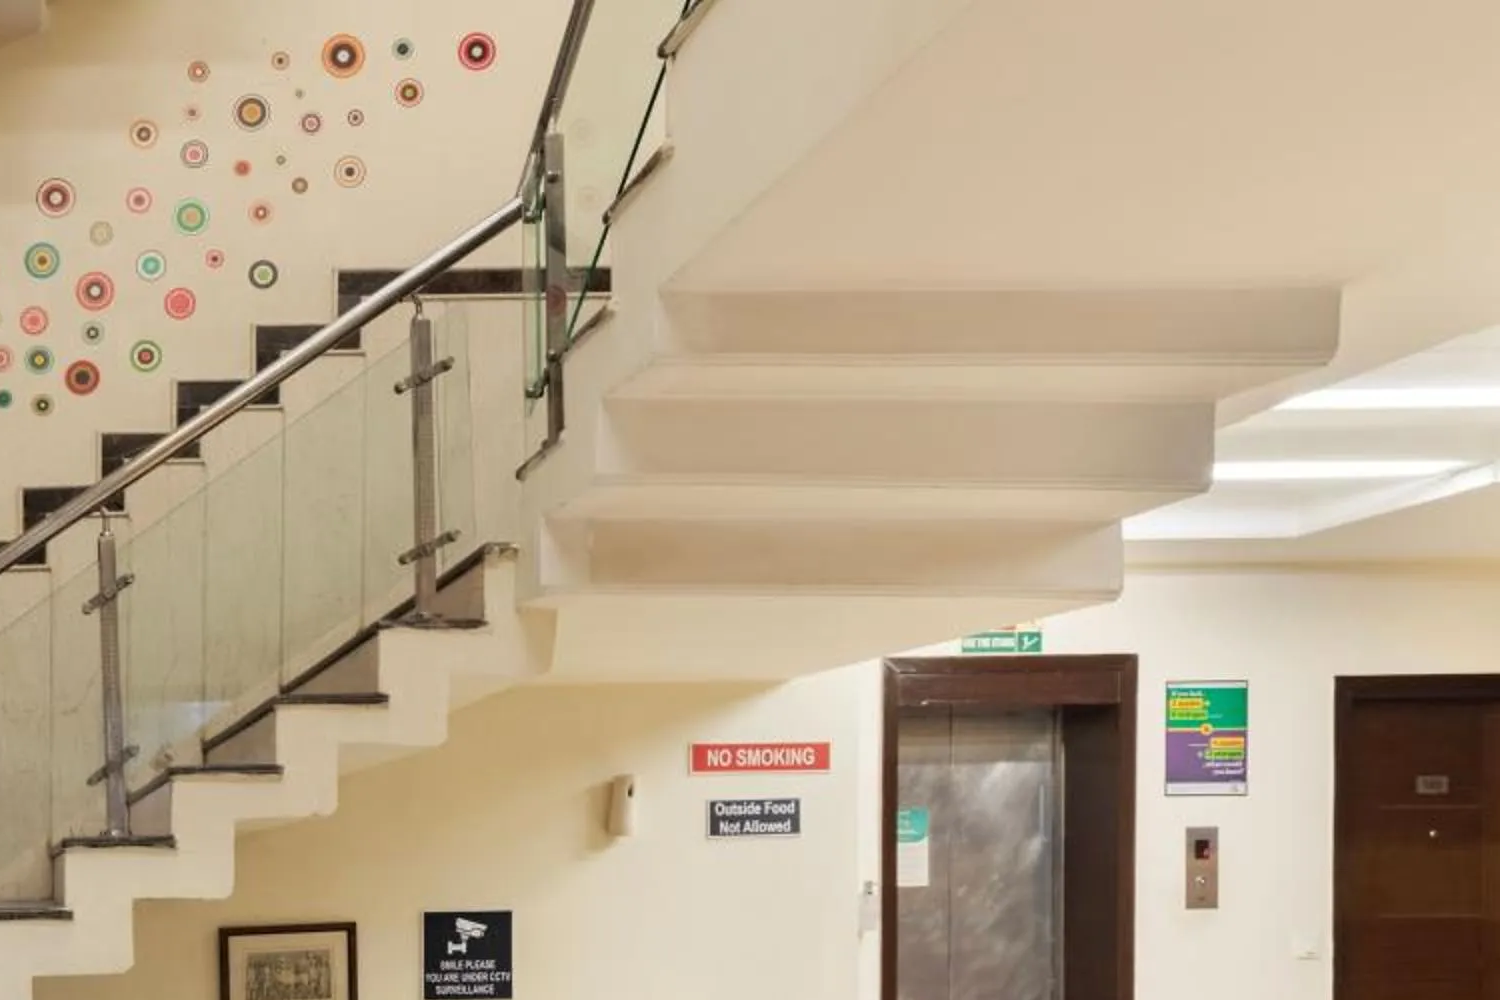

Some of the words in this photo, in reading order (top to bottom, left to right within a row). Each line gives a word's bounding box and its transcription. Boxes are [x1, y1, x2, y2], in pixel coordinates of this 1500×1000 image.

[707, 749, 732, 767] NO
[736, 747, 816, 766] SMOKING
[715, 802, 761, 815] Outside
[764, 801, 795, 814] Food
[719, 821, 740, 833] Not
[743, 820, 791, 833] Allowed
[465, 960, 496, 970] PLEASE
[489, 971, 511, 981] CCTV
